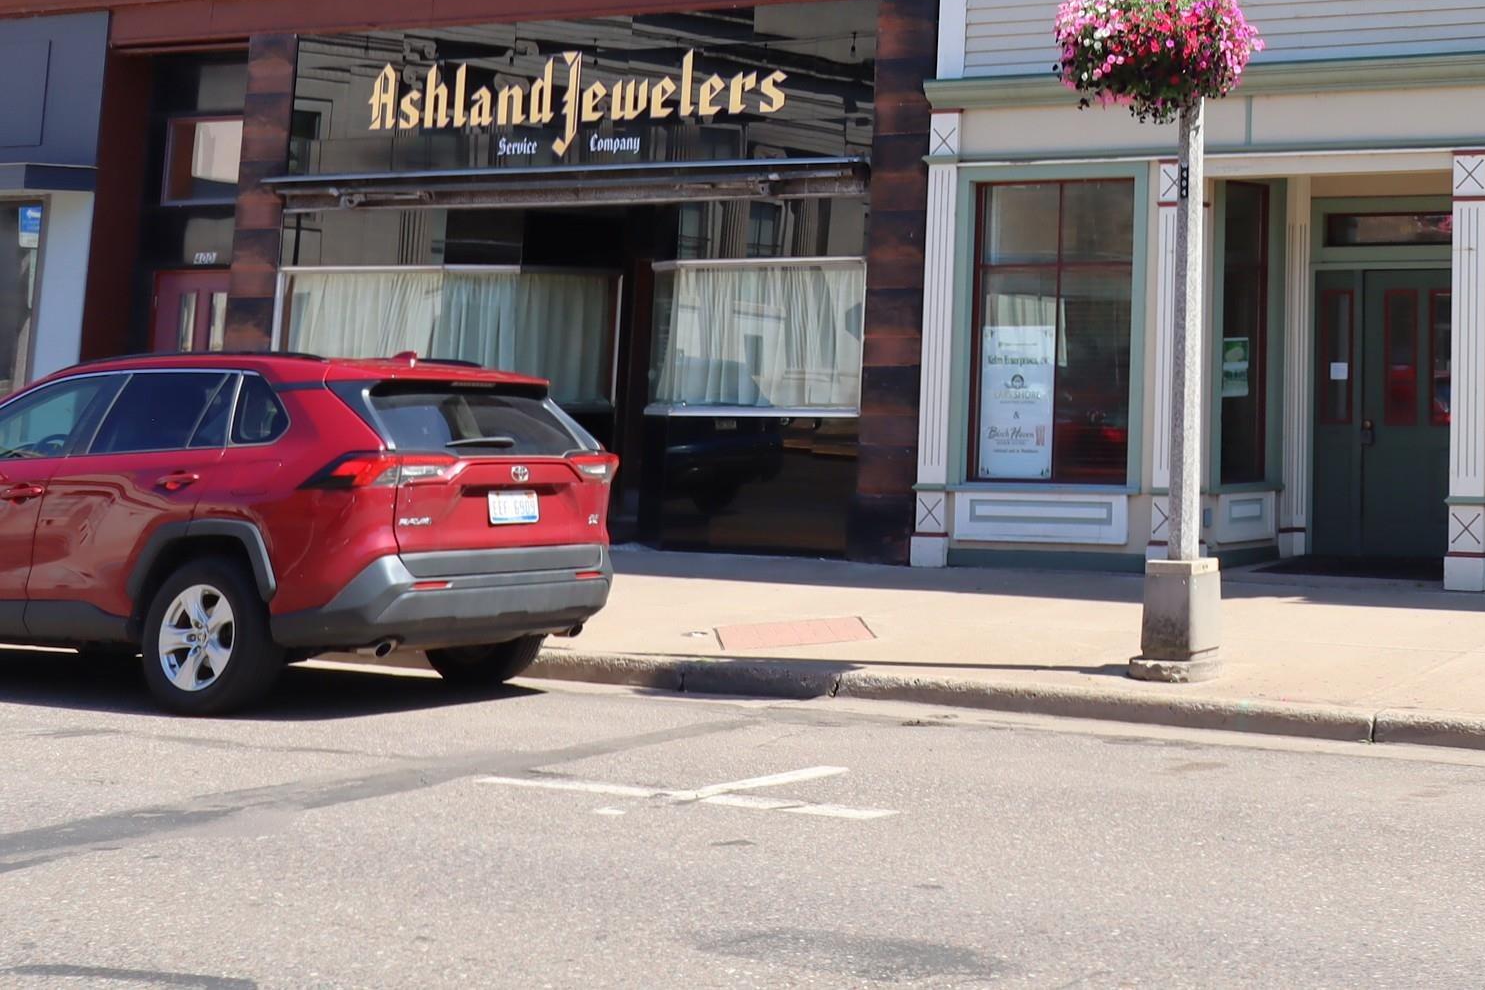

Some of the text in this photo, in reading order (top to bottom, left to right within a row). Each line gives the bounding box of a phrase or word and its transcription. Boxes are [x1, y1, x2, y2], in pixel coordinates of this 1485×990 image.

[368, 48, 788, 158] Ashland Jewelers
[497, 133, 641, 156] Service Company
